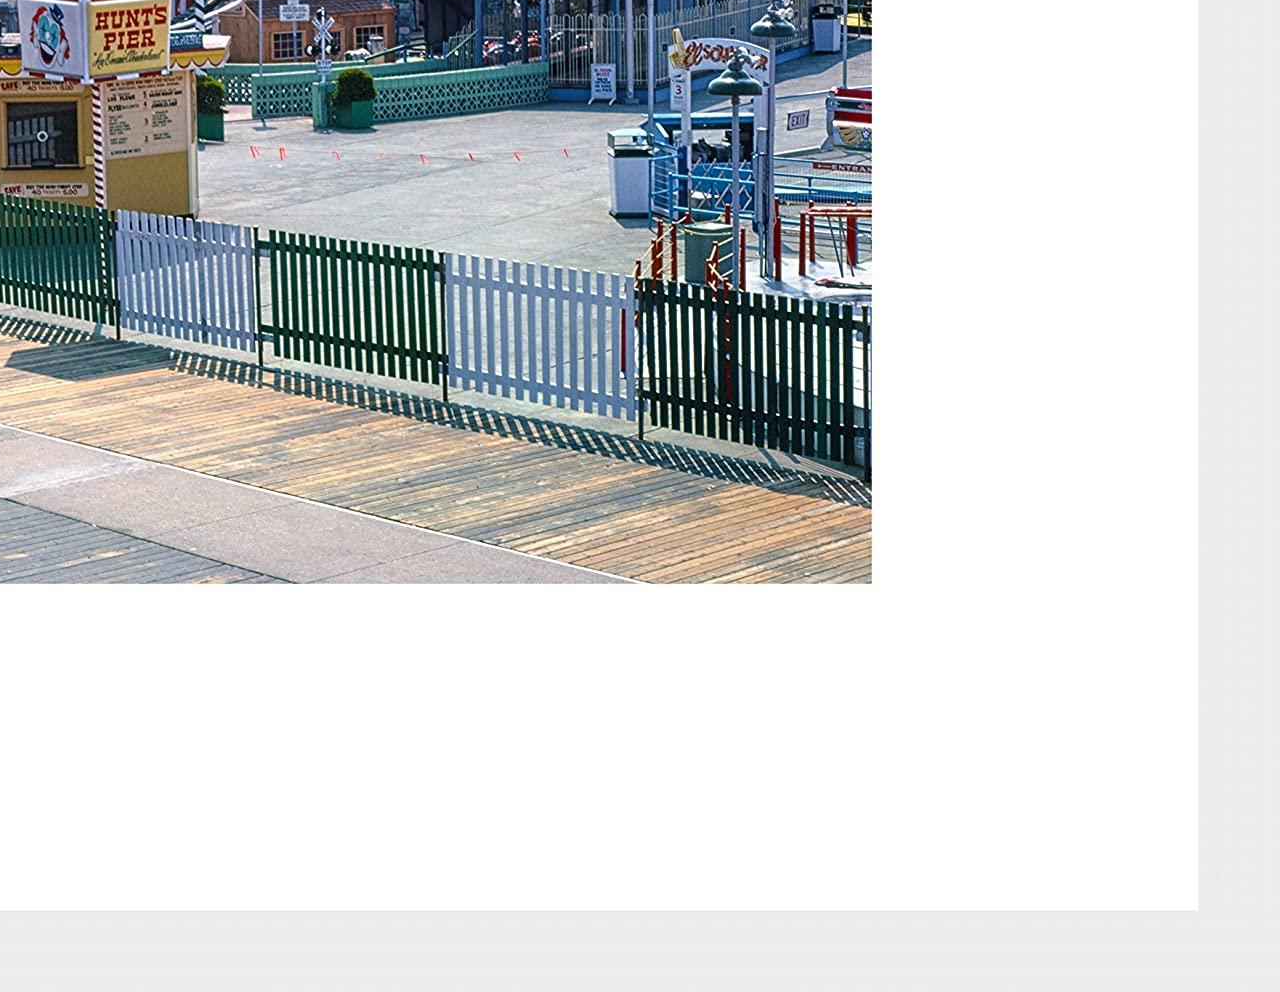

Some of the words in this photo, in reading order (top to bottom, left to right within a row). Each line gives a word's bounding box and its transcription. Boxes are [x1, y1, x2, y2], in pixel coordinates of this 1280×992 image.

[95, 4, 168, 30] HUNT'S
[104, 29, 156, 51] PIER
[675, 85, 682, 95] 3
[791, 114, 806, 127] EXIT
